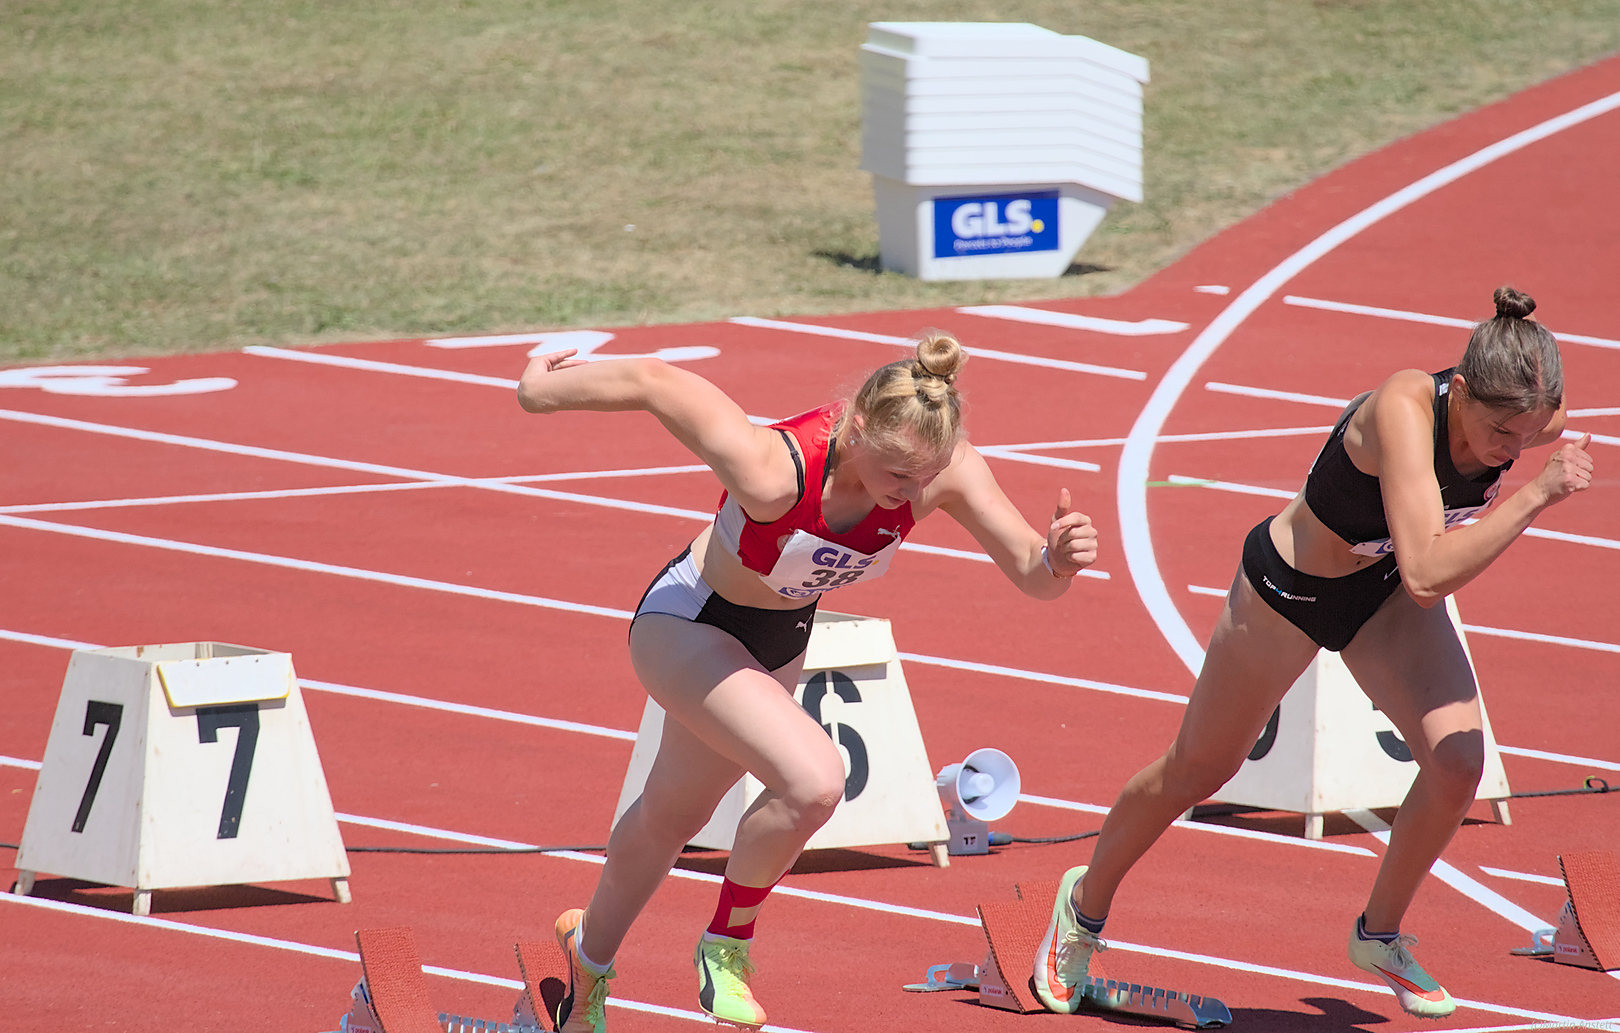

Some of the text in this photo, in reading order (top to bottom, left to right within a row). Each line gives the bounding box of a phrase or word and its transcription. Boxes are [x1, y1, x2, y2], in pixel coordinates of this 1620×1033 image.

[801, 569, 865, 588] 38
[1262, 575, 1317, 602] TOP4RUNNING
[71, 699, 124, 834] 7
[196, 703, 260, 840] 7
[802, 670, 869, 803] 6
